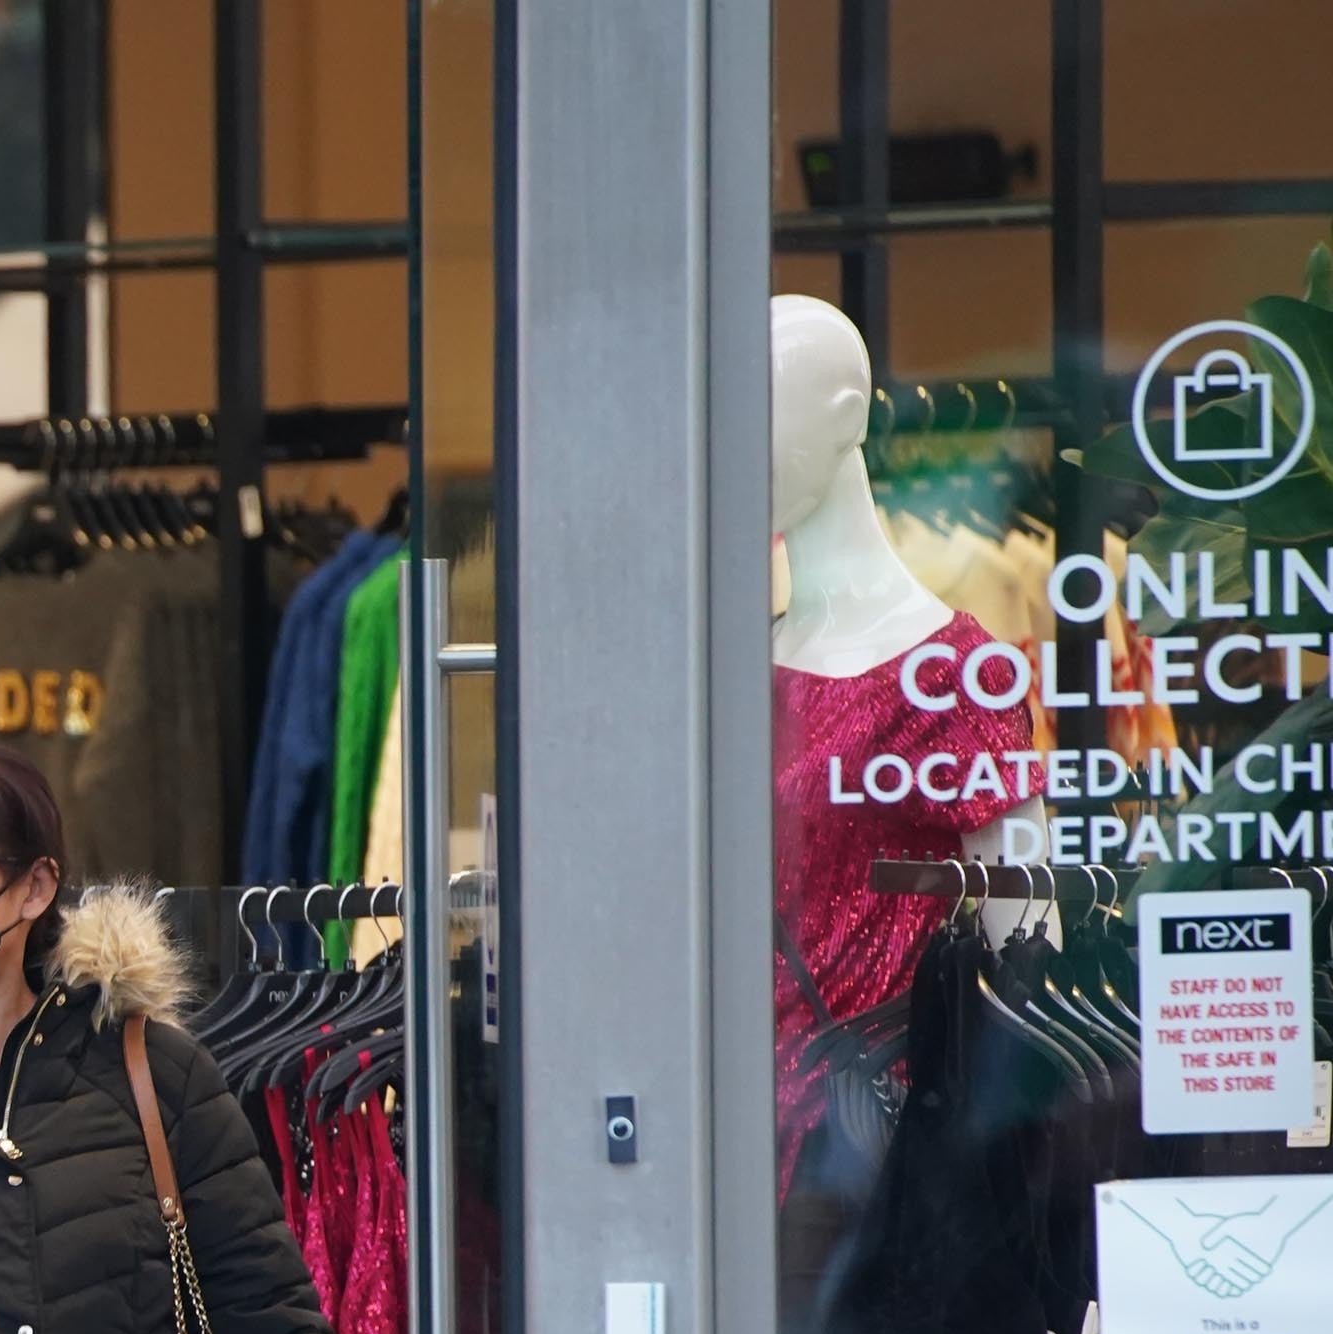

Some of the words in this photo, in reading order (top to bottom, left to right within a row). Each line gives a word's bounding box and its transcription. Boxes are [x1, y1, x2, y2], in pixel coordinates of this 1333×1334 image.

[1047, 547, 1333, 623] ONLIN
[828, 747, 1130, 805] LOCATED
[1149, 746, 1214, 797] IN
[1234, 742, 1333, 794] CH
[1175, 918, 1275, 950] next
[1170, 979, 1219, 996] STAFF
[1224, 978, 1246, 994] DO
[1252, 976, 1283, 993] NOT
[1160, 1004, 1201, 1020] HAVE
[1207, 1002, 1269, 1018] ACCESS
[1274, 1001, 1294, 1017] TO
[1156, 1029, 1186, 1045] THE
[1191, 1027, 1274, 1044] CONTENTS
[1279, 1025, 1300, 1041] OF
[1180, 1053, 1210, 1069] THE
[1215, 1052, 1255, 1068] SAFE
[1260, 1051, 1277, 1066] IN
[1183, 1077, 1219, 1093] THIS
[1223, 1075, 1275, 1092] STORE
[1202, 1319, 1231, 1331] This
[1235, 1319, 1246, 1331] is
[1250, 1321, 1260, 1331] a
